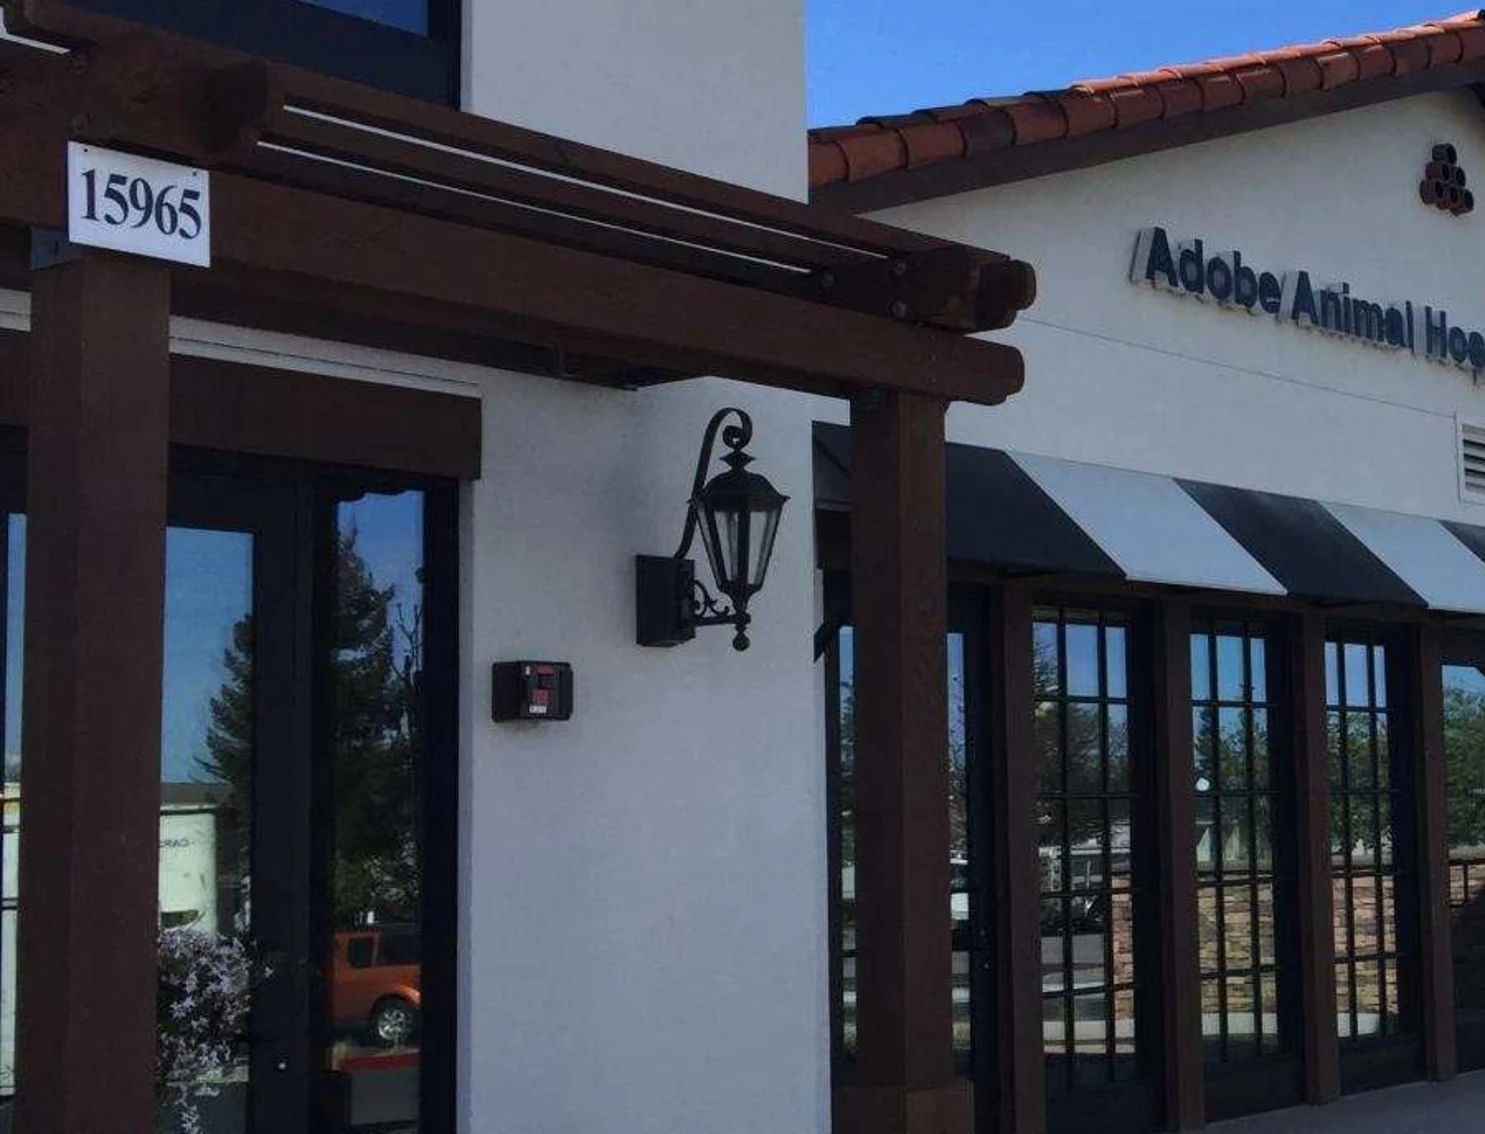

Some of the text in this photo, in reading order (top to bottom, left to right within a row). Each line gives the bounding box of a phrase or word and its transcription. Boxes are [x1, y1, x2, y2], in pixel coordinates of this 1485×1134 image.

[81, 168, 202, 240] 15965
[1138, 226, 1282, 315] Adobe
[1289, 270, 1414, 350] Animal
